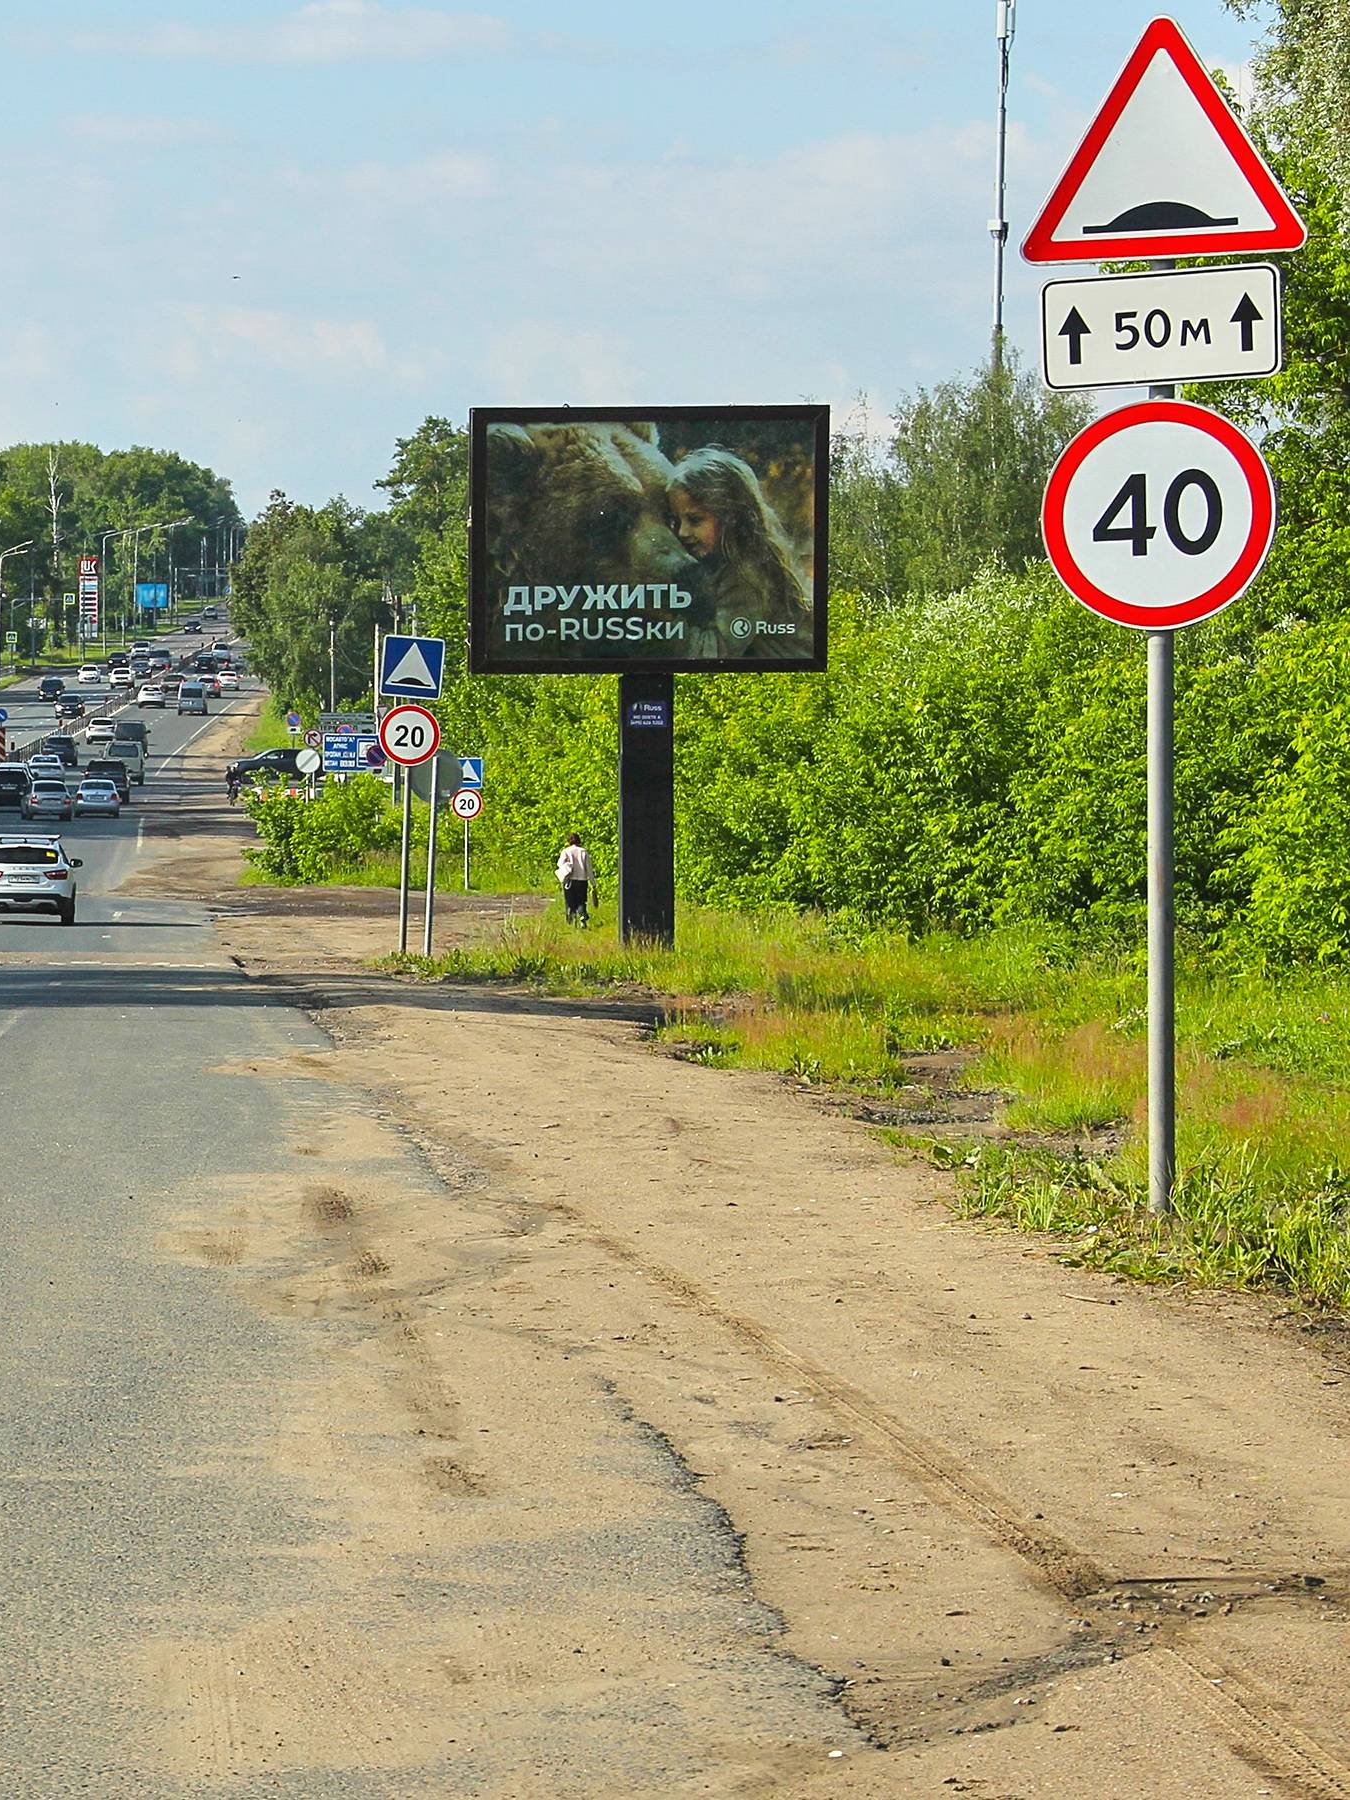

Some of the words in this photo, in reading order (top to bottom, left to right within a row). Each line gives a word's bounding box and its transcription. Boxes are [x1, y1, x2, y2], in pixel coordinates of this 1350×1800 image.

[1092, 468, 1223, 557] 40
[503, 583, 692, 616] ДРУЖИТЬ
[755, 620, 796, 635] Russ
[393, 724, 425, 748] 20
[459, 798, 475, 810] 20
